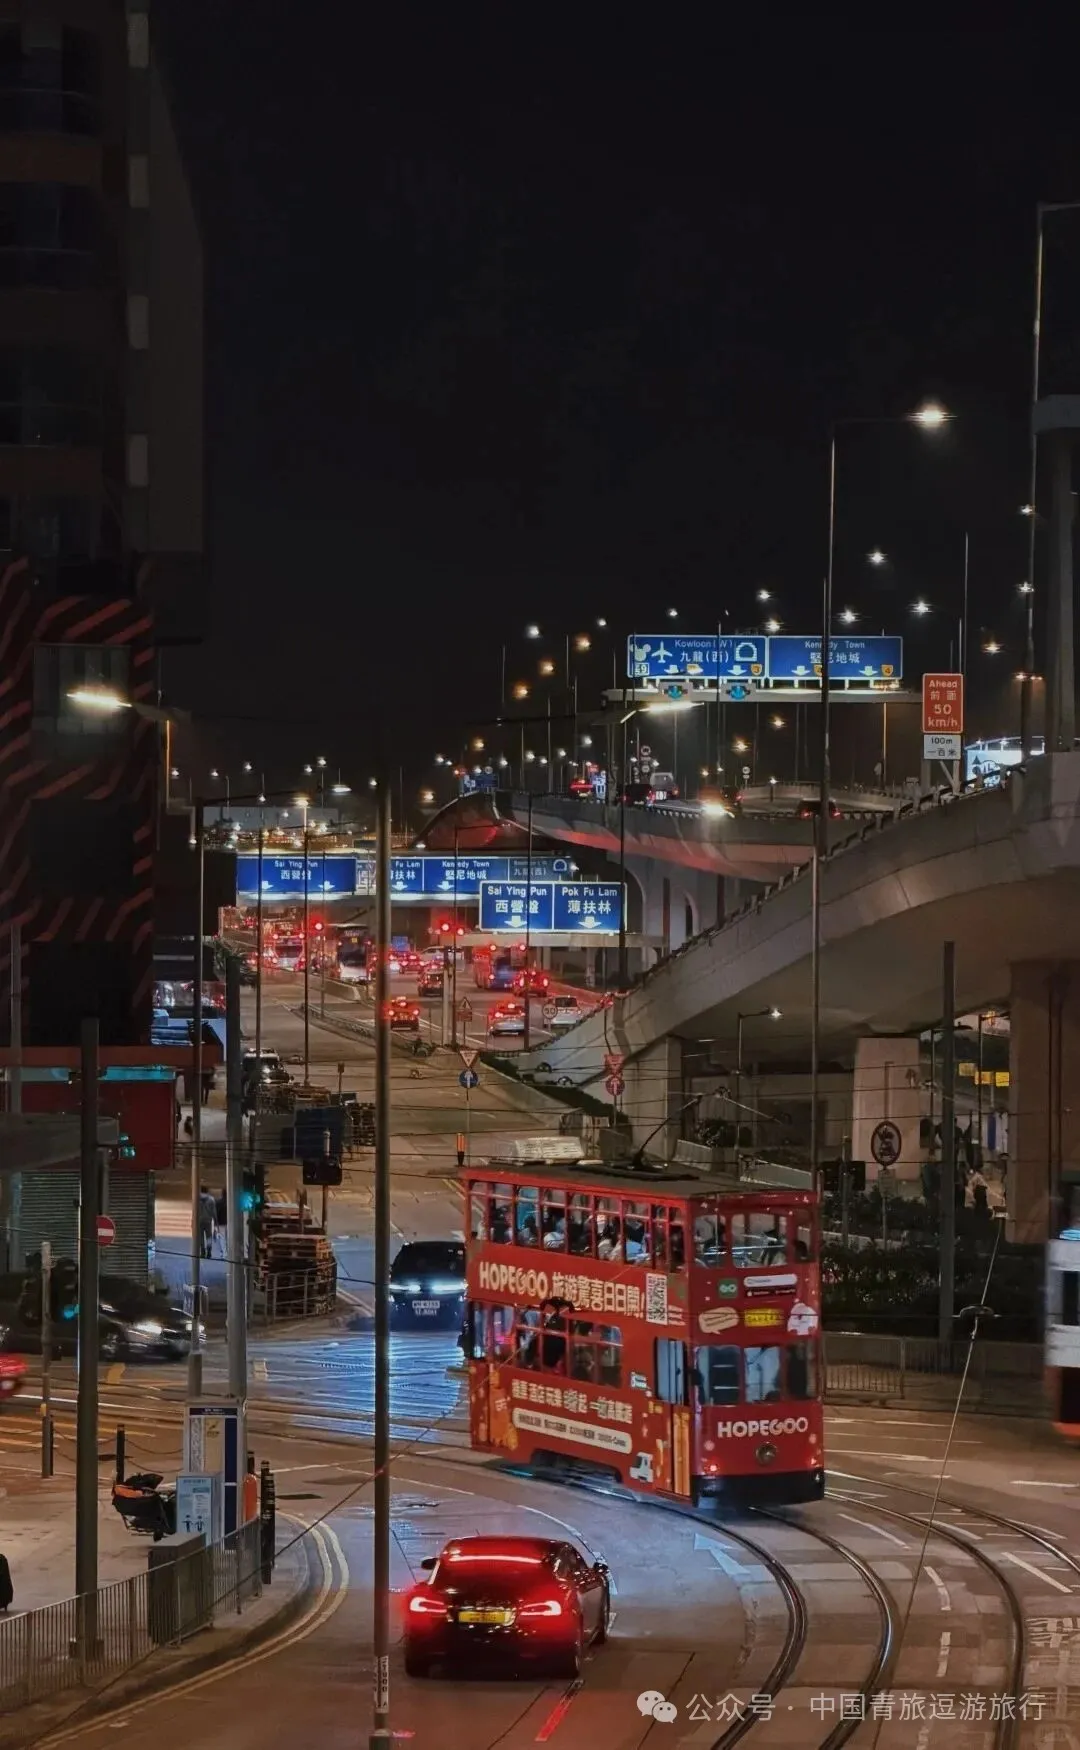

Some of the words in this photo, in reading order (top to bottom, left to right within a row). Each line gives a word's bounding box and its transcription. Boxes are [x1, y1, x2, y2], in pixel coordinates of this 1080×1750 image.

[675, 640, 711, 648] Kowloon
[805, 641, 838, 650] Kendy
[929, 680, 958, 688] Ahead
[934, 703, 952, 715] 50
[927, 716, 958, 728] km/h
[931, 737, 953, 745] 100m
[289, 860, 303, 869] Ying
[442, 861, 469, 869] Kenedy
[445, 869, 487, 880] 堅尼地城
[487, 886, 502, 896] Sai
[506, 886, 527, 898] Ying
[530, 887, 547, 896] Pun
[562, 887, 579, 897] Pok
[583, 887, 594, 897] Fu
[598, 887, 618, 897] Lam
[567, 899, 612, 914] 薄扶林
[717, 1416, 808, 1438] HOPEGOO
